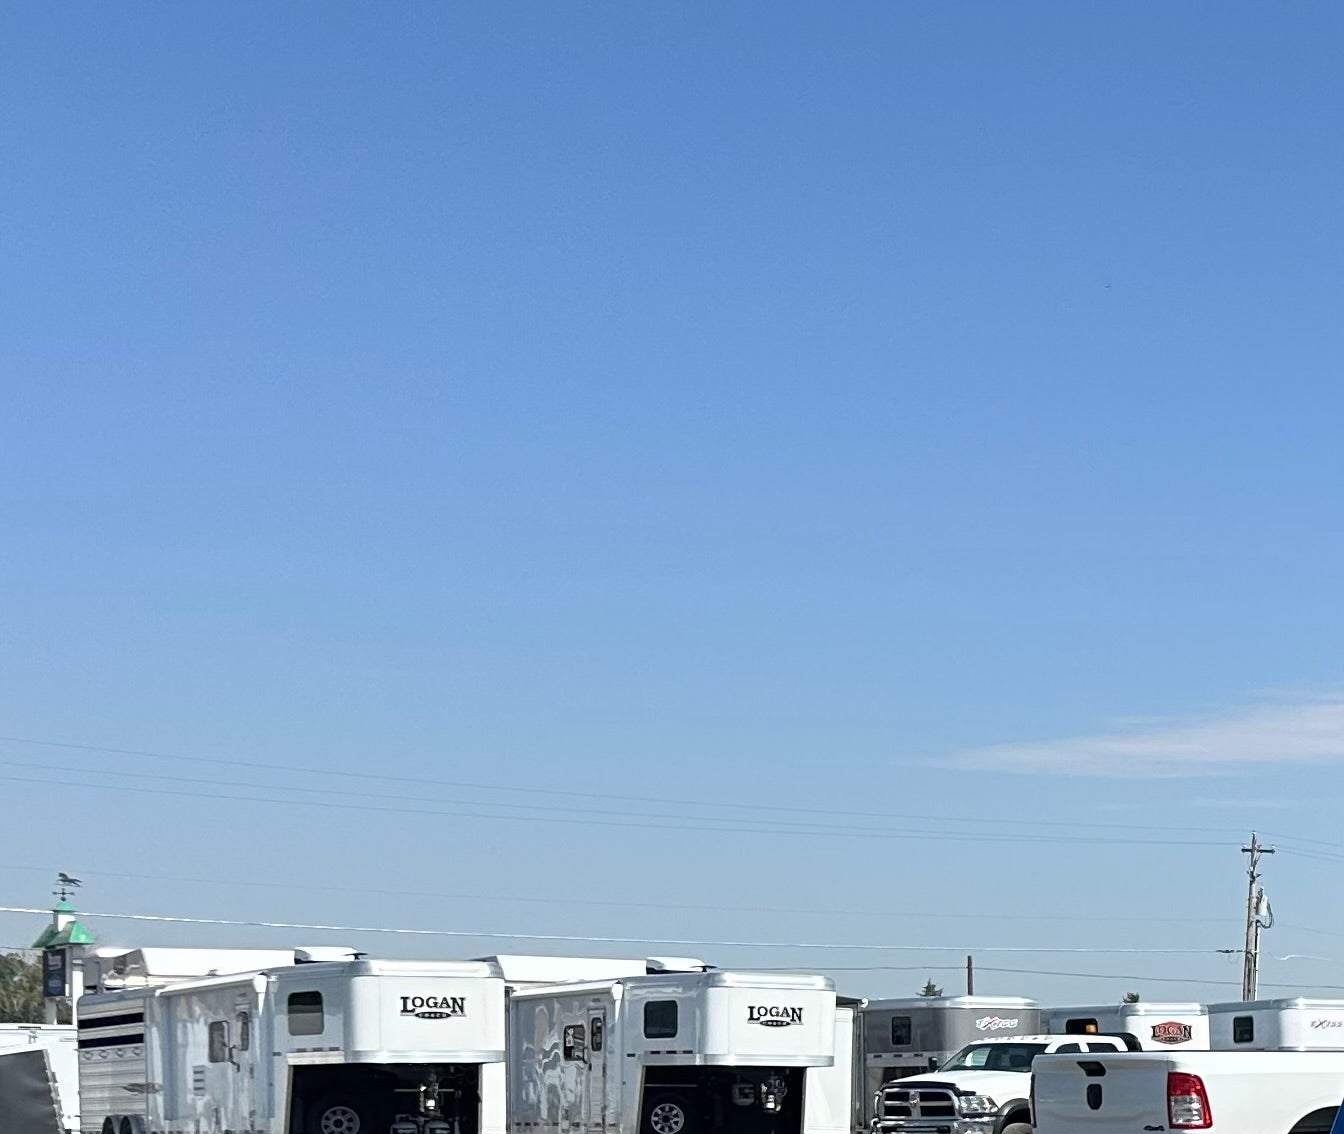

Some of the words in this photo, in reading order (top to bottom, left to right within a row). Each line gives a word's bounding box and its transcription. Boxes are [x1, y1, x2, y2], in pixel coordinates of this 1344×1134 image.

[400, 996, 466, 1014] LOGAN
[748, 1006, 803, 1022] LOGAN
[1151, 1024, 1192, 1040] LOGAN
